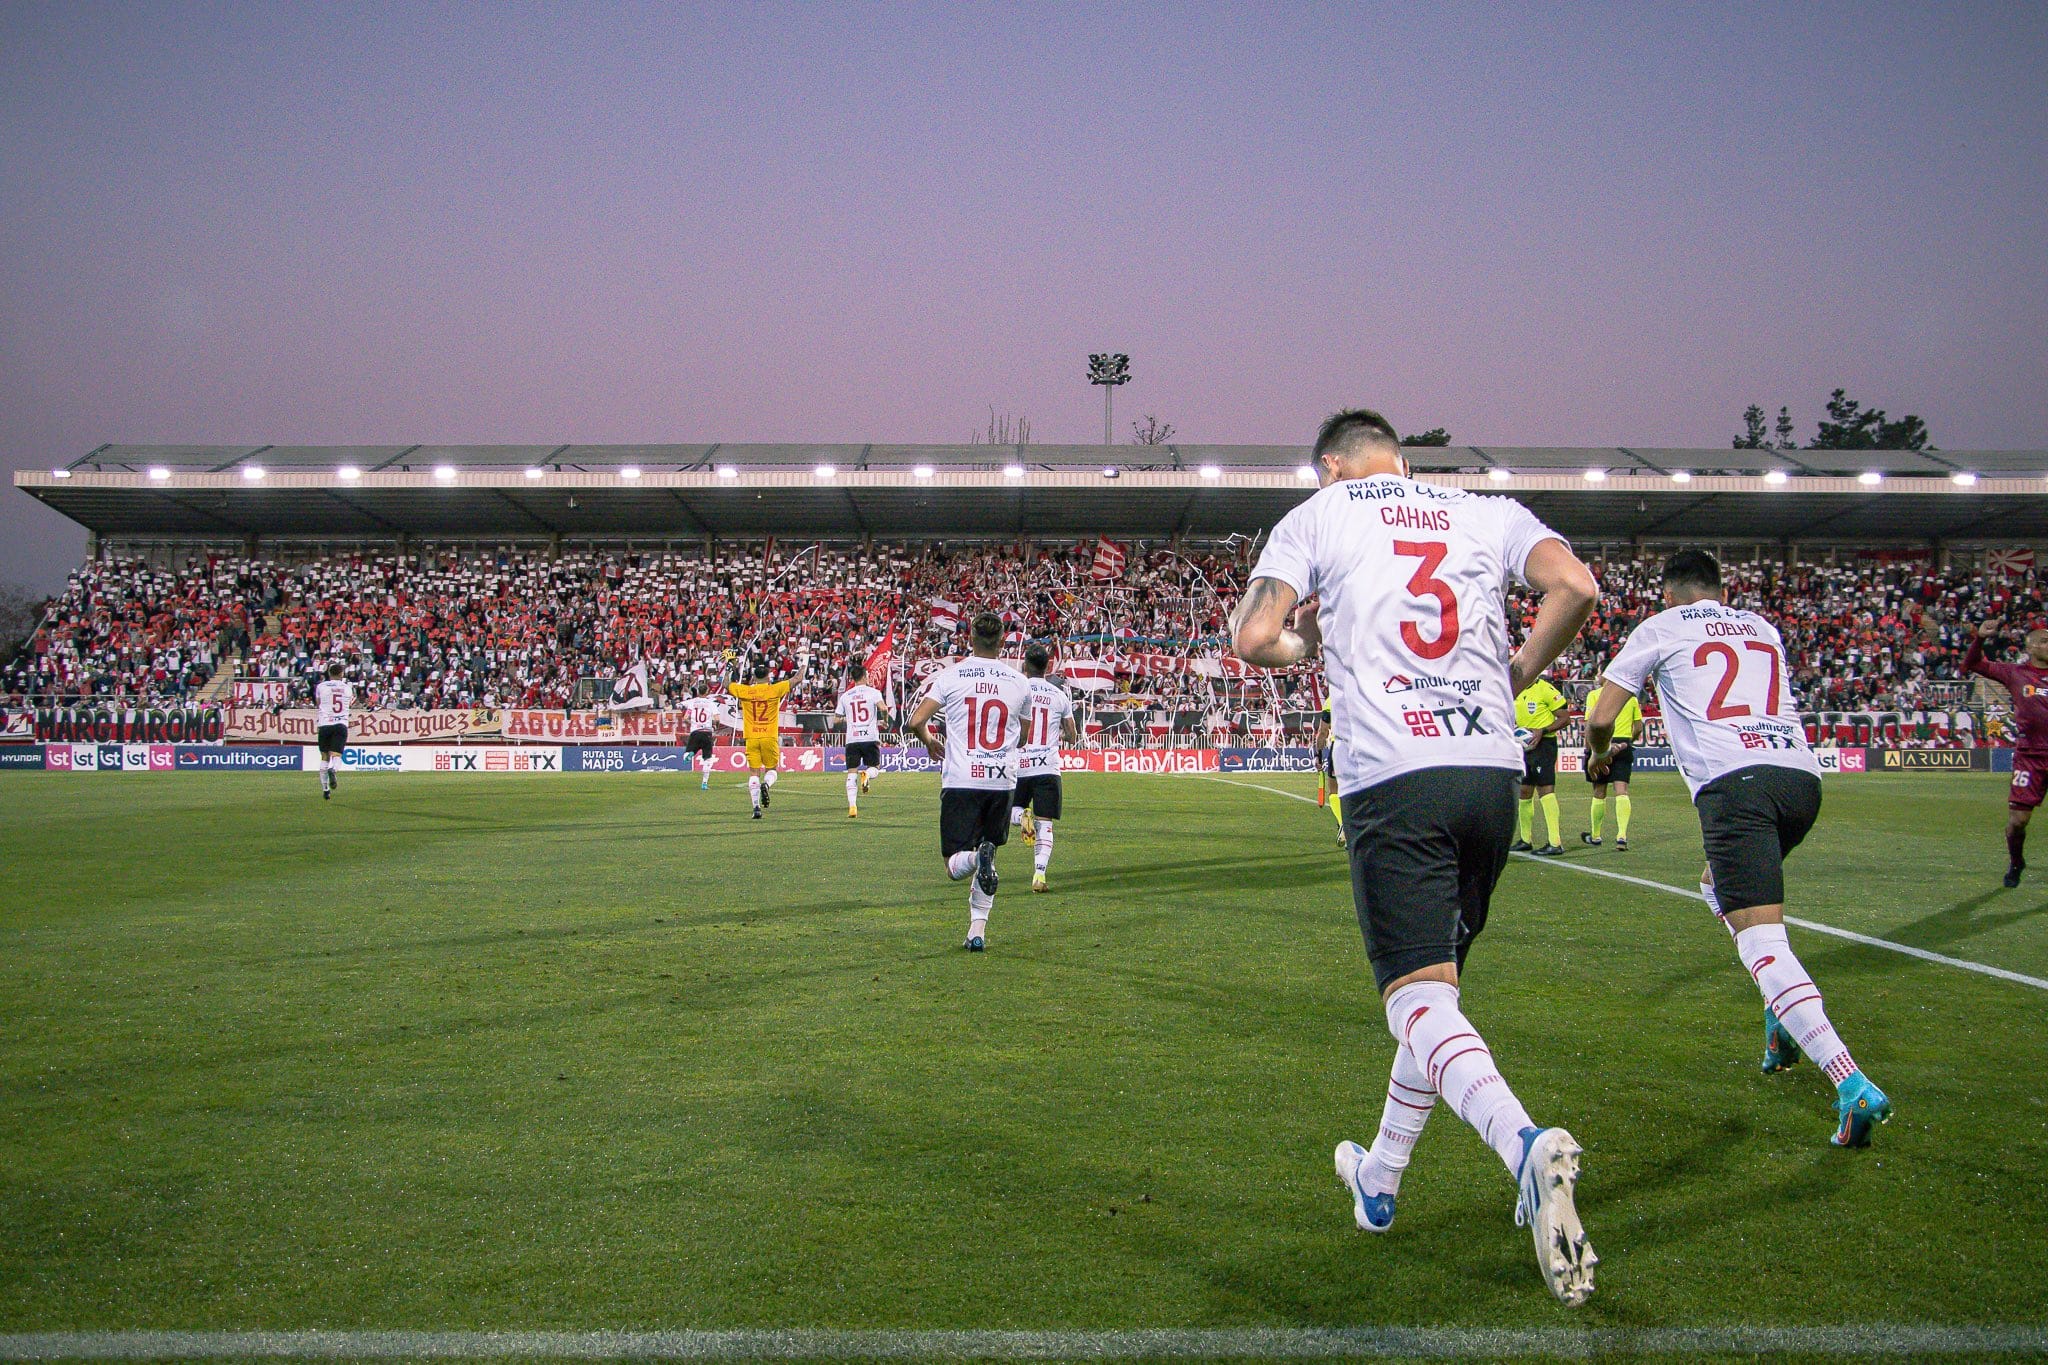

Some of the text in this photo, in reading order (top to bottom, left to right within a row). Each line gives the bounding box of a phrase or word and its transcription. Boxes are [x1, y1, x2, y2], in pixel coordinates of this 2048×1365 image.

[1346, 482, 1376, 490] RUTA
[1349, 487, 1405, 500] MAIPO
[1380, 505, 1450, 531] CAHAIS
[1393, 539, 1460, 660] 3
[1682, 612, 1721, 620] MAIPO
[1705, 622, 1758, 637] COELHO
[975, 682, 999, 695] LEIVA
[1414, 675, 1482, 695] multogar
[1694, 640, 1780, 721] 27
[264, 683, 284, 702] 13
[332, 694, 343, 713] 5
[751, 700, 769, 721] 12
[850, 700, 869, 722] 15
[694, 707, 707, 723] 16
[964, 696, 1009, 750] 10
[1432, 705, 1490, 737] TX
[508, 711, 598, 737] AGUAS
[1028, 707, 1049, 745] 11
[1, 754, 42, 762] HYUNDAI
[48, 750, 70, 766] ist
[73, 751, 94, 767] ist
[100, 750, 121, 766] ist
[126, 751, 147, 766] ist
[151, 750, 172, 766] ist
[202, 753, 298, 767] multihogar
[450, 754, 477, 769] TX
[529, 754, 556, 769] TX
[582, 758, 624, 769] MAIPO
[632, 749, 677, 765] isa
[1030, 756, 1047, 767] TX
[1104, 750, 1204, 772] PlanVital
[1636, 754, 1676, 767] mult
[1817, 753, 1838, 768] ist
[1841, 752, 1862, 768] ist
[1905, 753, 1965, 765] ARUNA
[985, 765, 1007, 779] TX
[2012, 769, 2031, 787] 26
